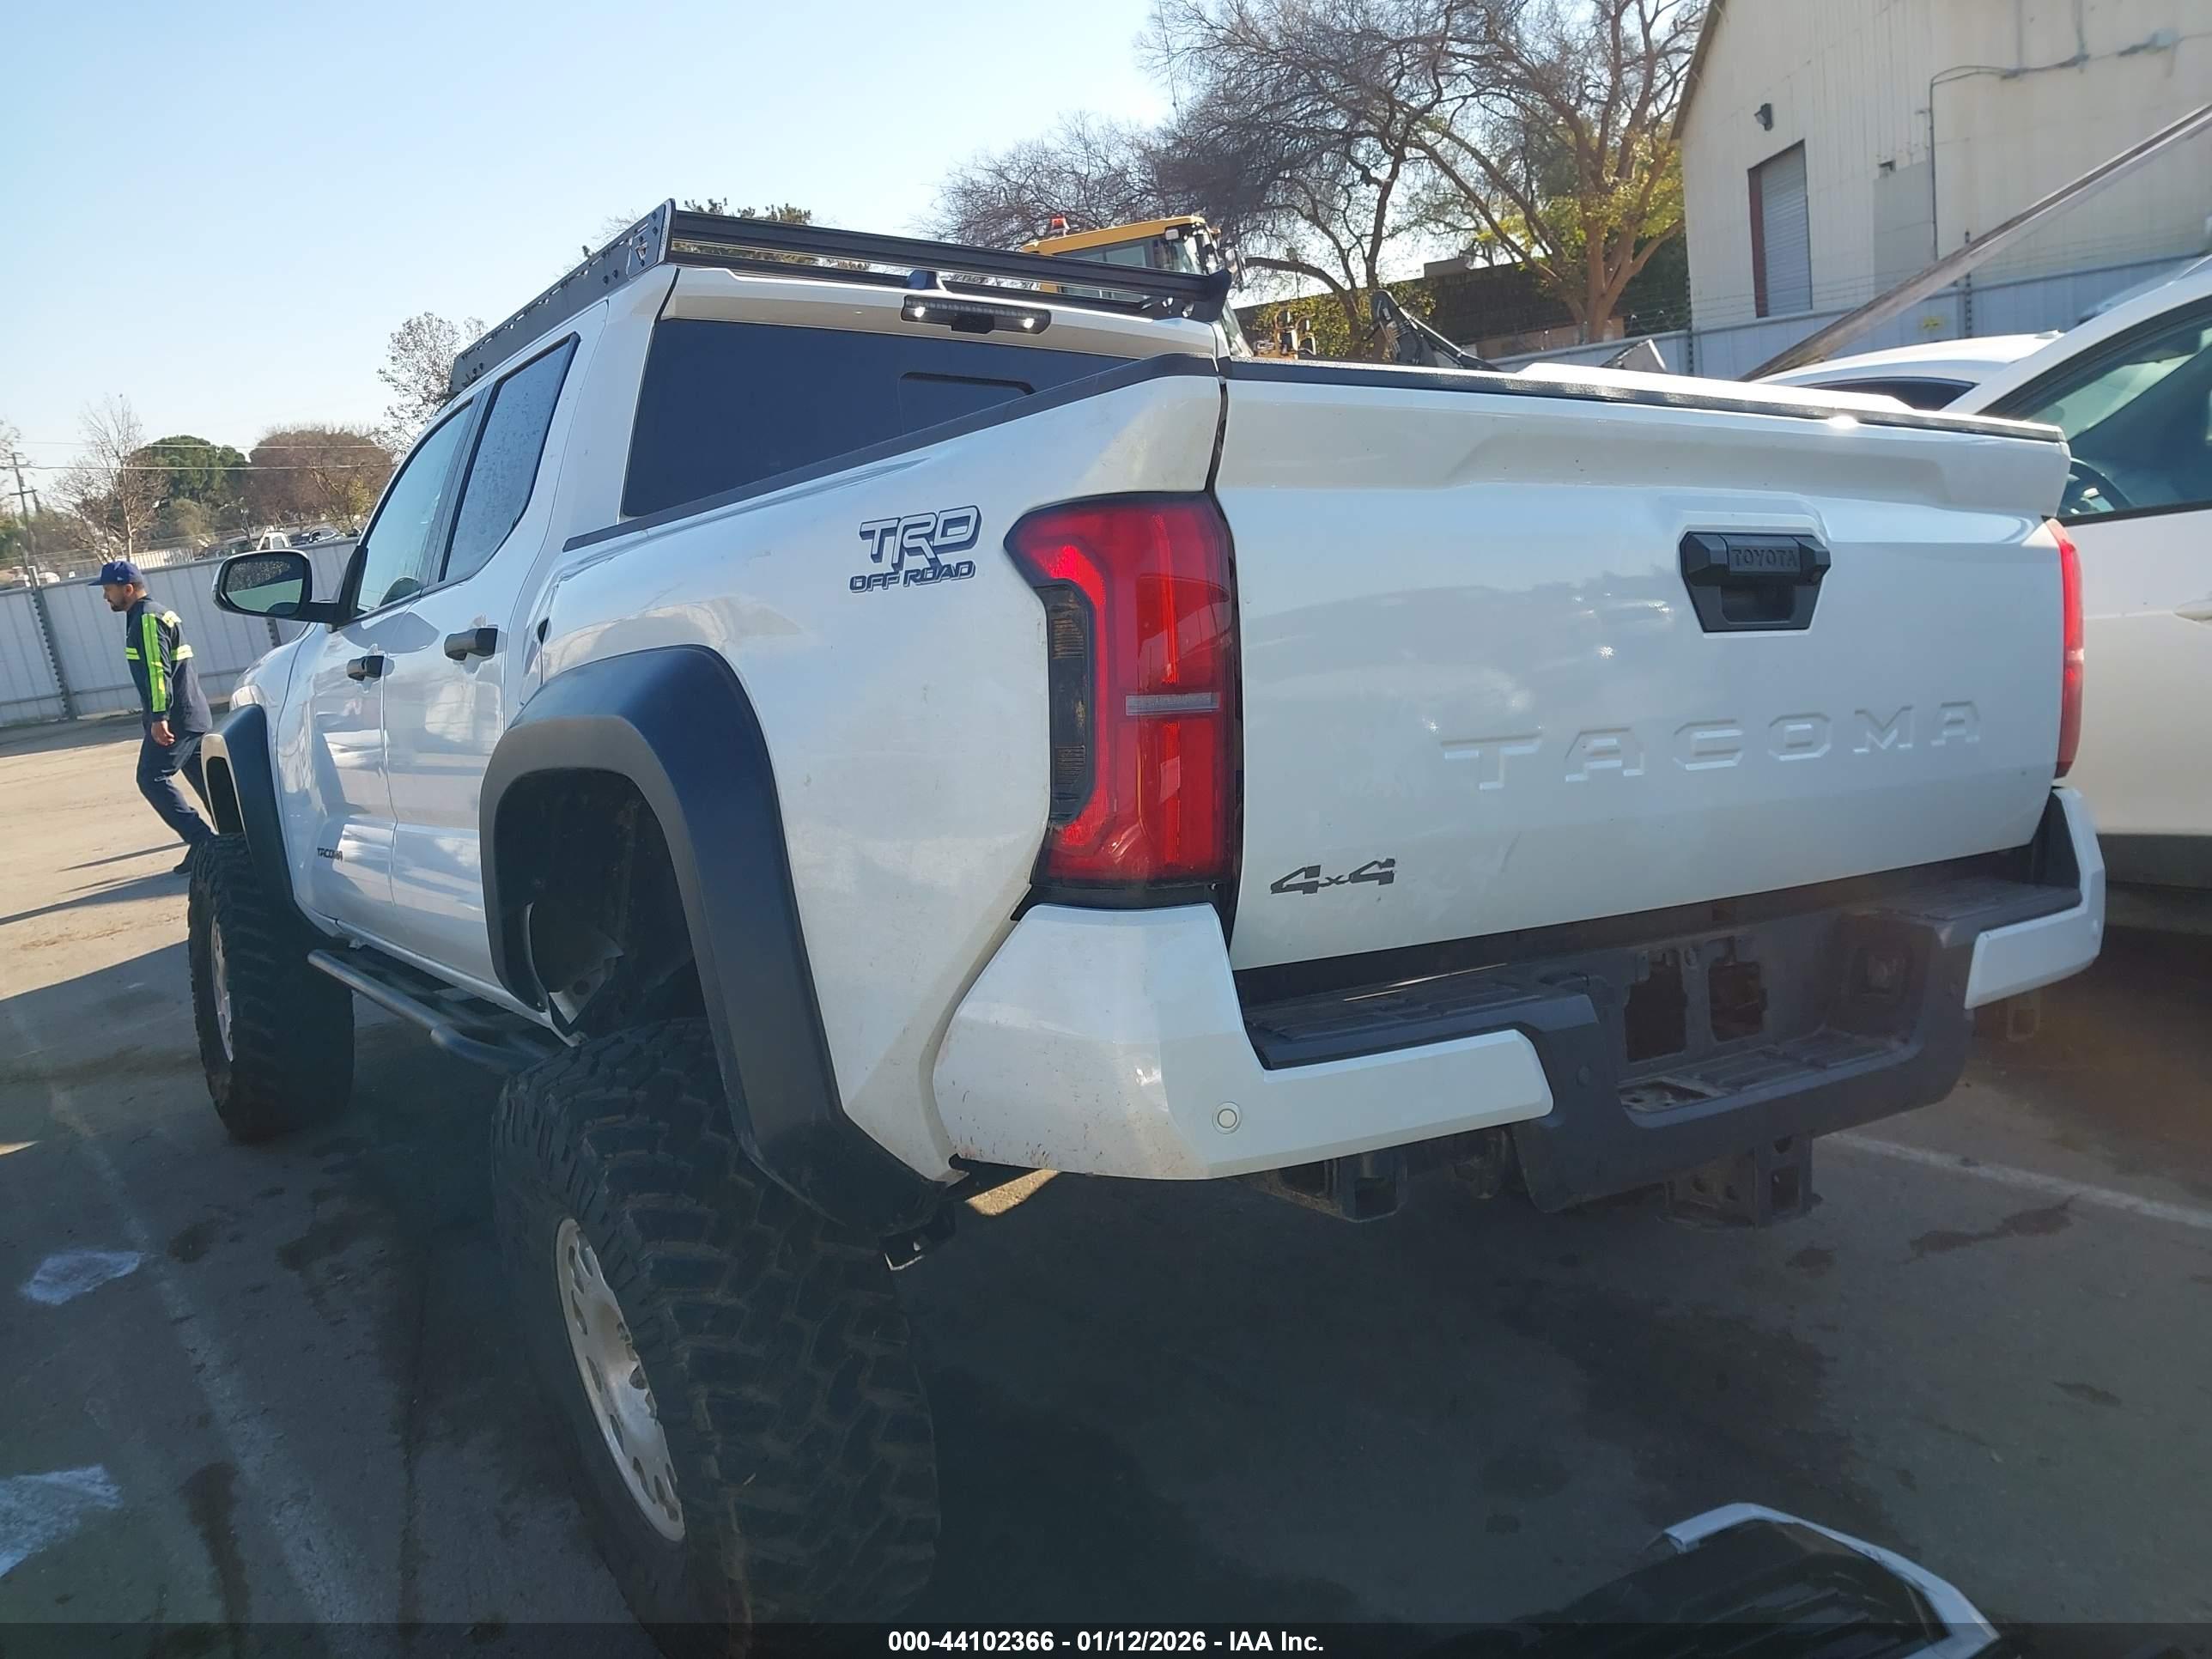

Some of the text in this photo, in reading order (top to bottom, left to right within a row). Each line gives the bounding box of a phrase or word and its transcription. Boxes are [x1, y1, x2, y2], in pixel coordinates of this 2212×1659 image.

[859, 505, 981, 572] TRD
[1730, 548, 1799, 568] TOYOTA
[849, 560, 976, 593] OFF ROAD
[1439, 699, 1981, 791] TACOMA
